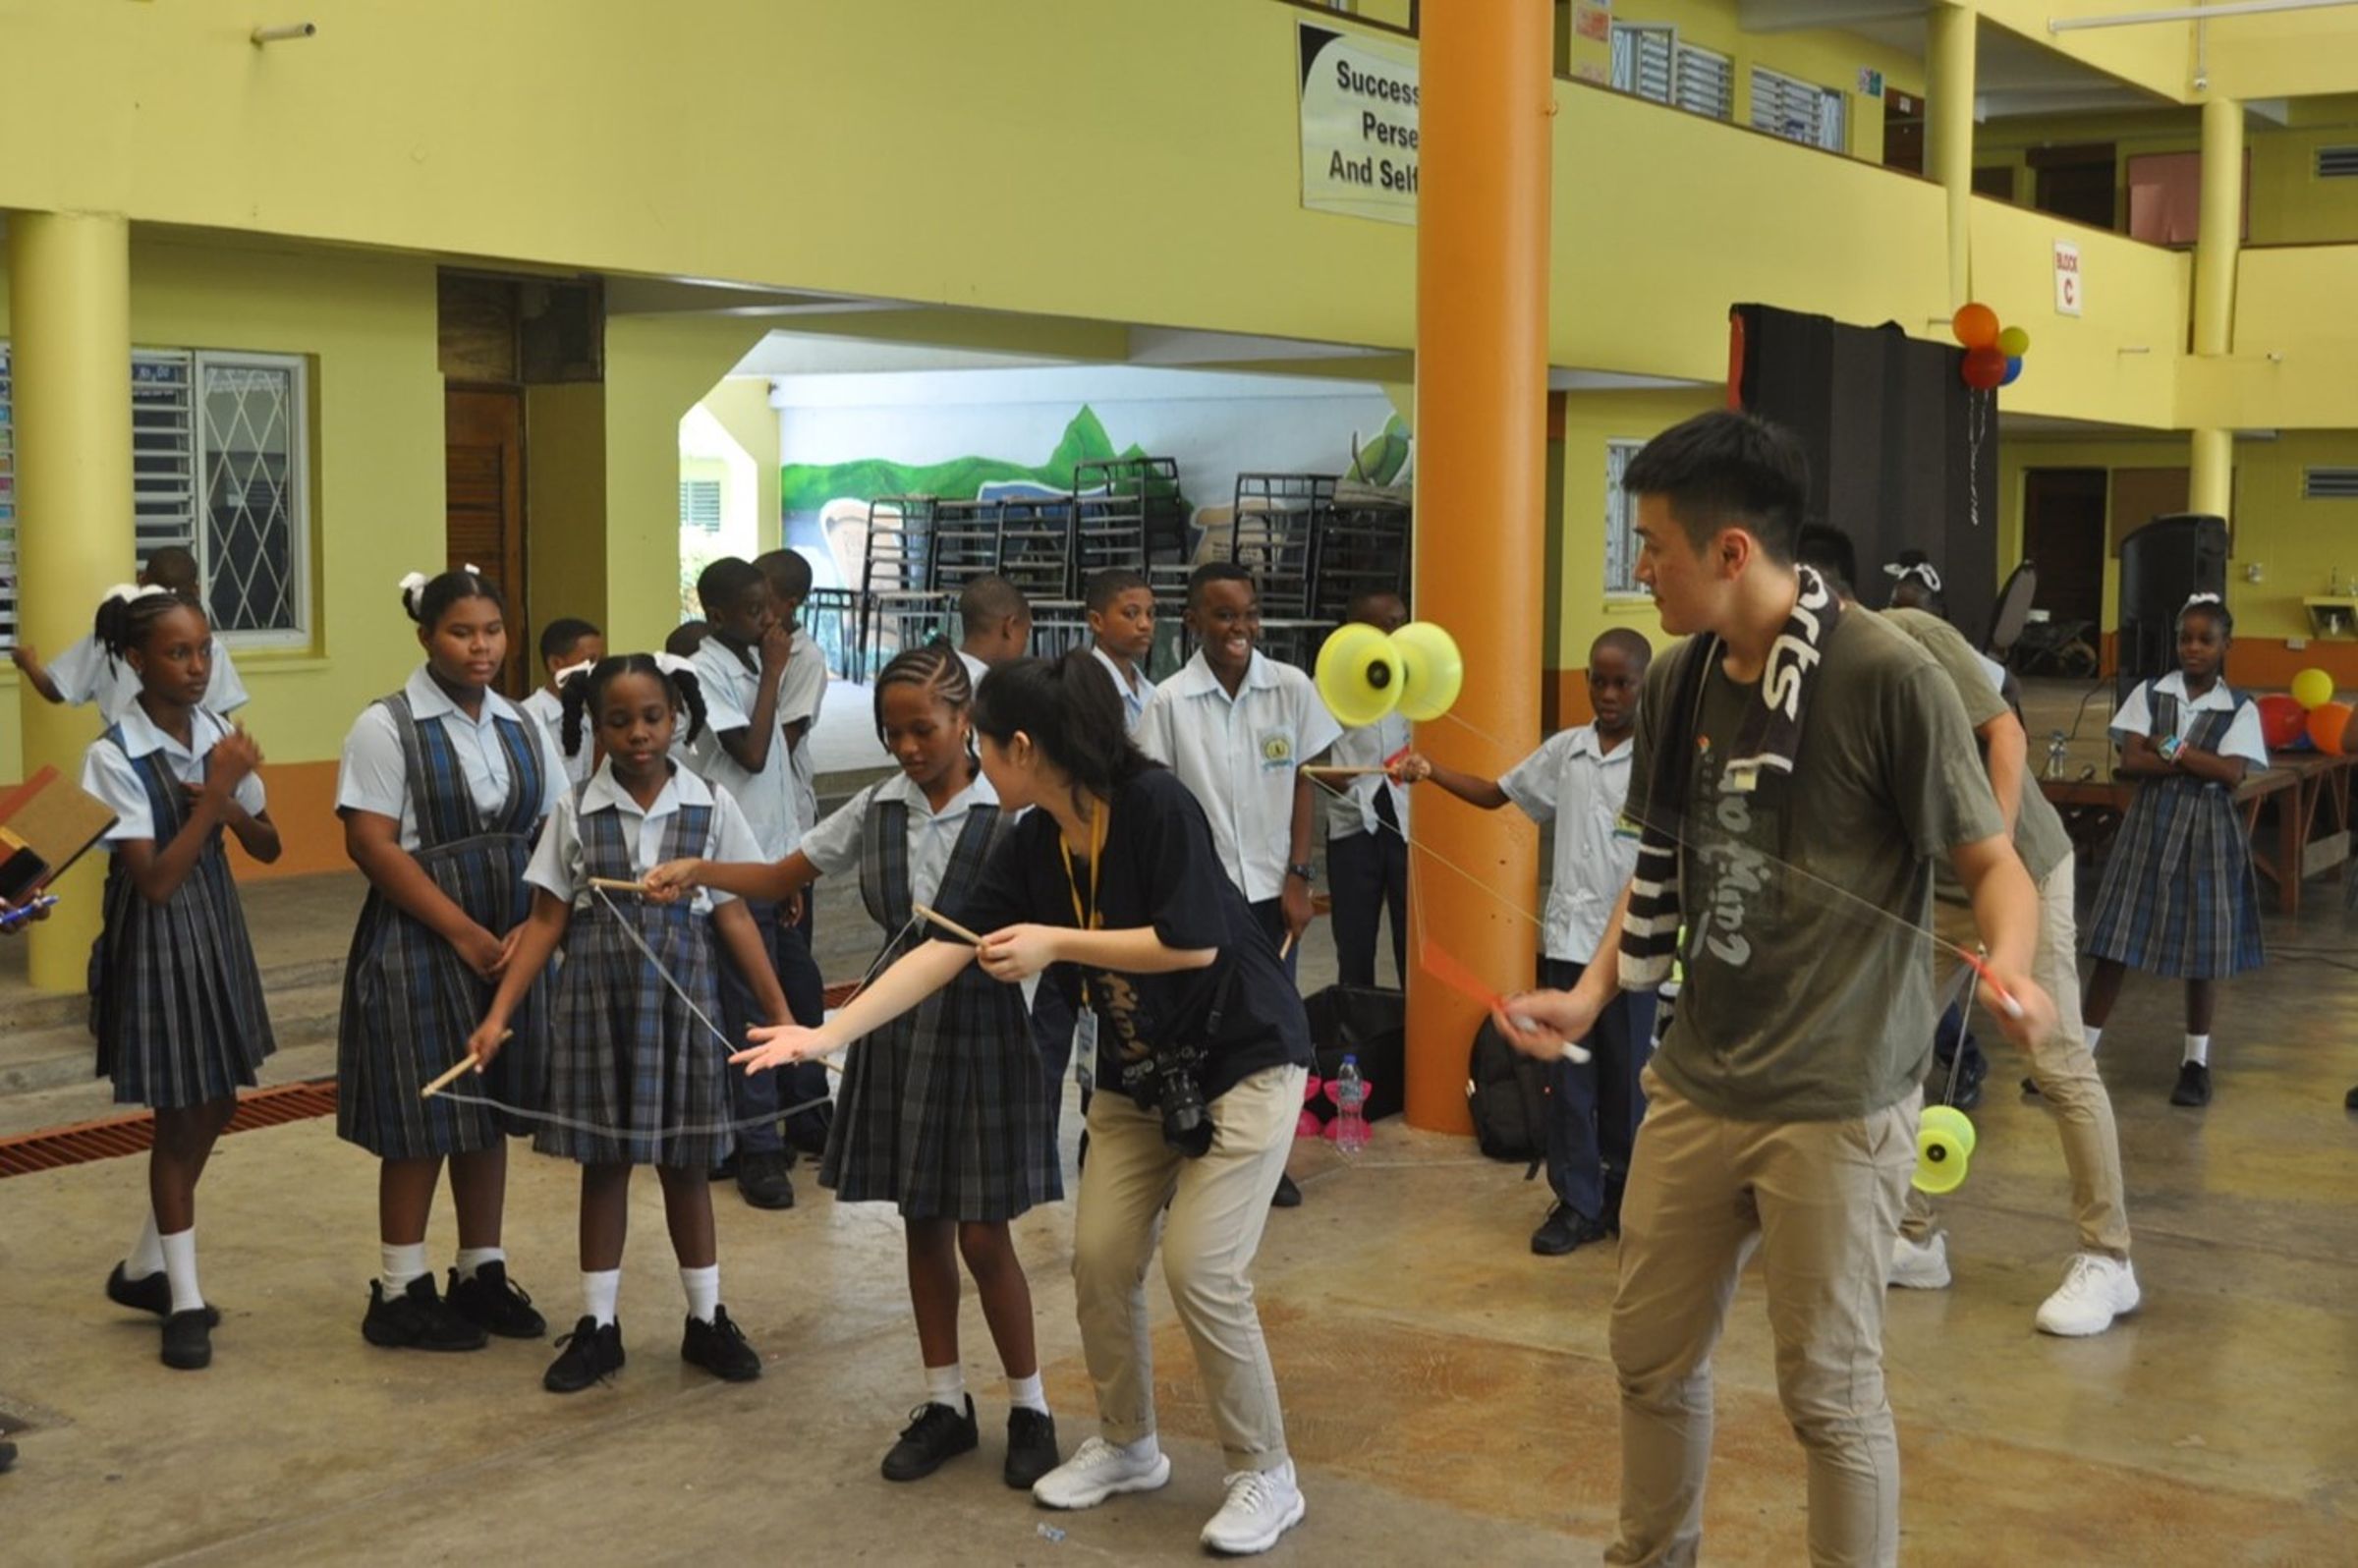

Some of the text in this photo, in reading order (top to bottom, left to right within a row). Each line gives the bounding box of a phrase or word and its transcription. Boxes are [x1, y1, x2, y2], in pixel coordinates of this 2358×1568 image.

[1336, 60, 1420, 105] Success
[1363, 111, 1419, 149] Perse
[1329, 150, 1373, 186] And
[2064, 278, 2073, 306] C
